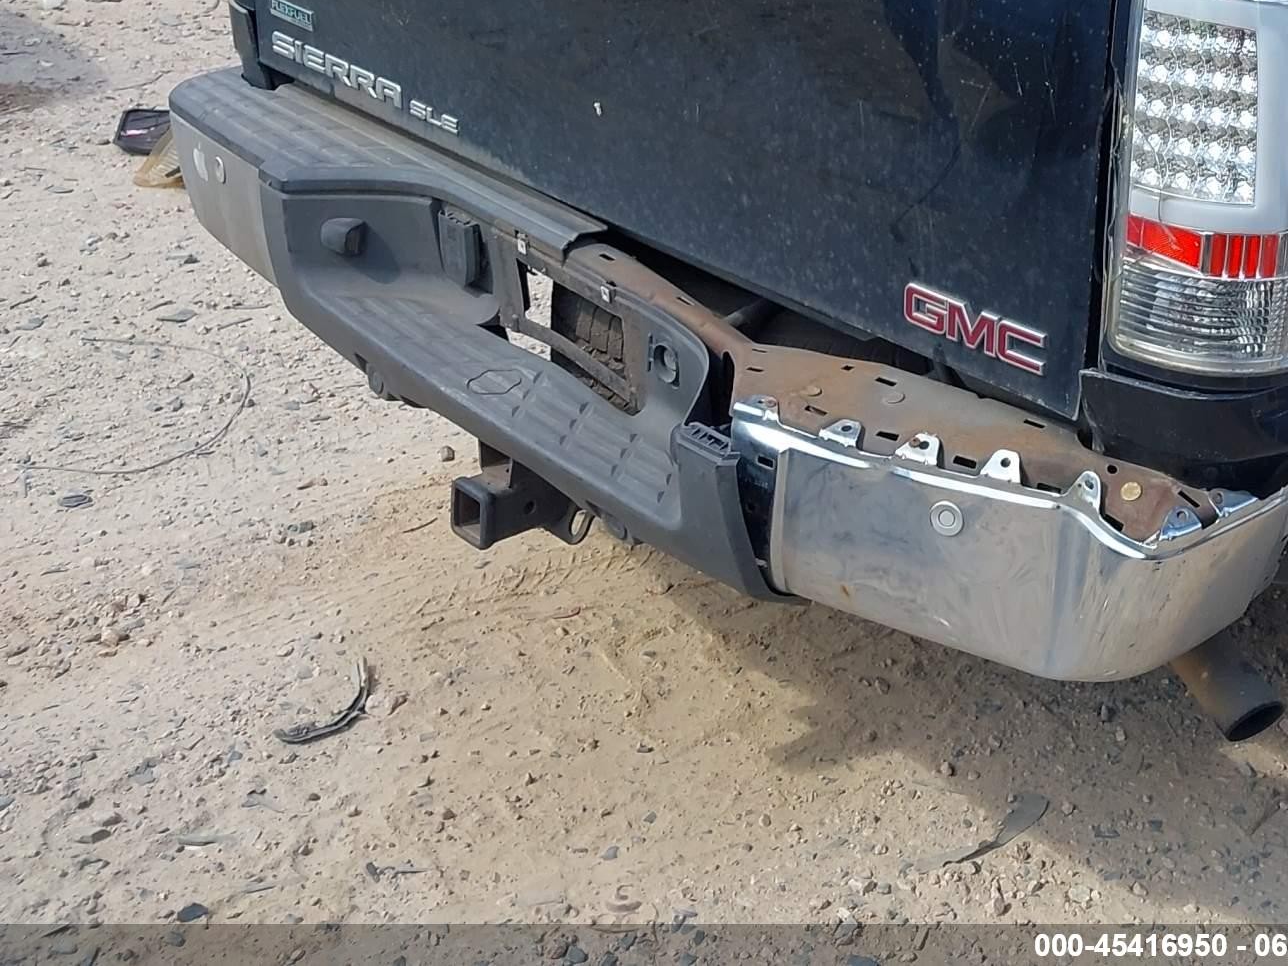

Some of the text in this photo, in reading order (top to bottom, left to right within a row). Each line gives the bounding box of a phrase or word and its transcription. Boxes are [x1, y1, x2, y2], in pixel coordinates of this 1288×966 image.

[271, 0, 312, 24] FLEXFUEL
[272, 31, 459, 135] SIERRA SLE
[903, 282, 1048, 376] GMC
